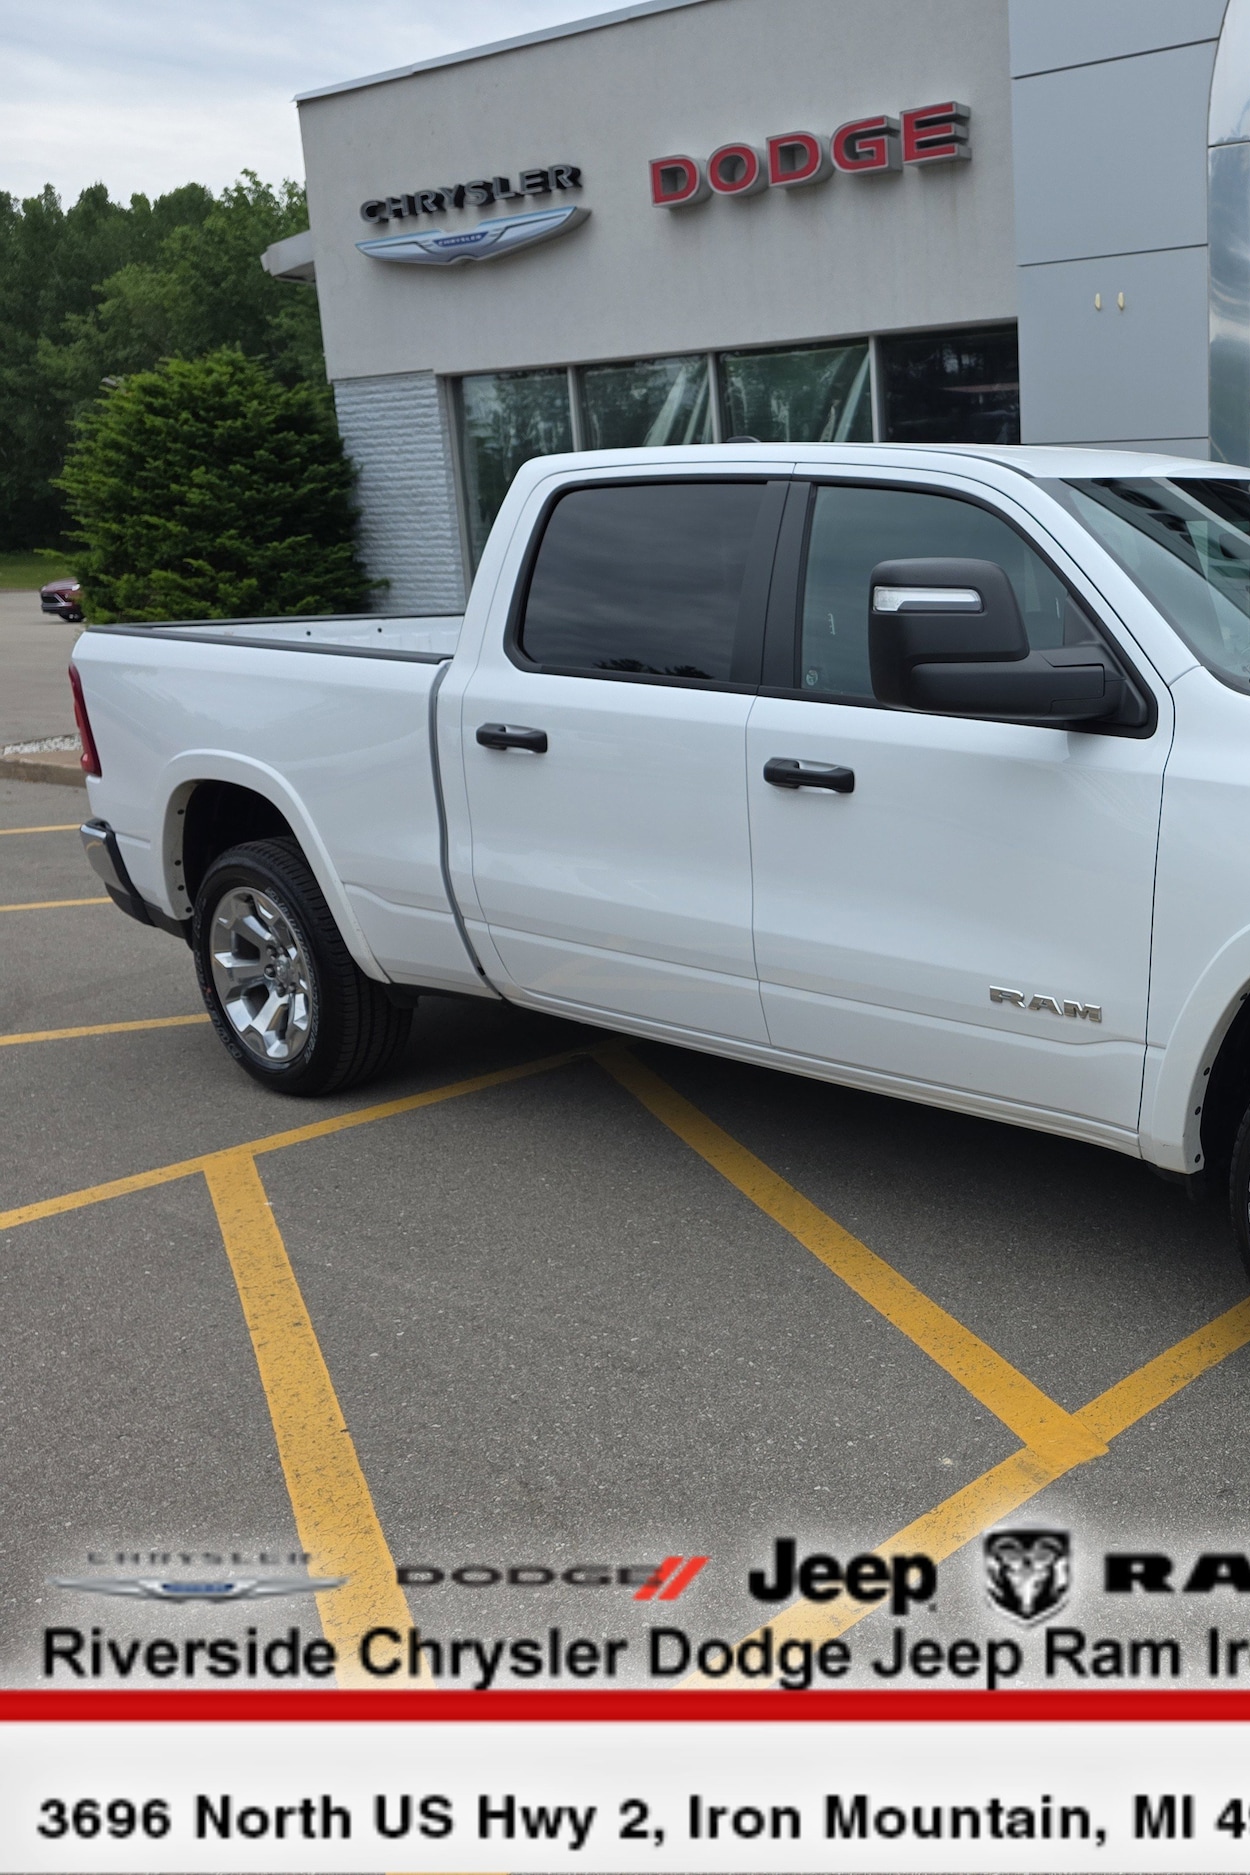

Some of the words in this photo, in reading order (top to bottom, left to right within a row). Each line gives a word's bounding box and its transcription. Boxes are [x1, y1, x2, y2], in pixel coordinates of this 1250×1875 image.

[649, 102, 971, 208] DODGE
[359, 163, 583, 225] CHRYSLER
[989, 985, 1102, 1023] RAM
